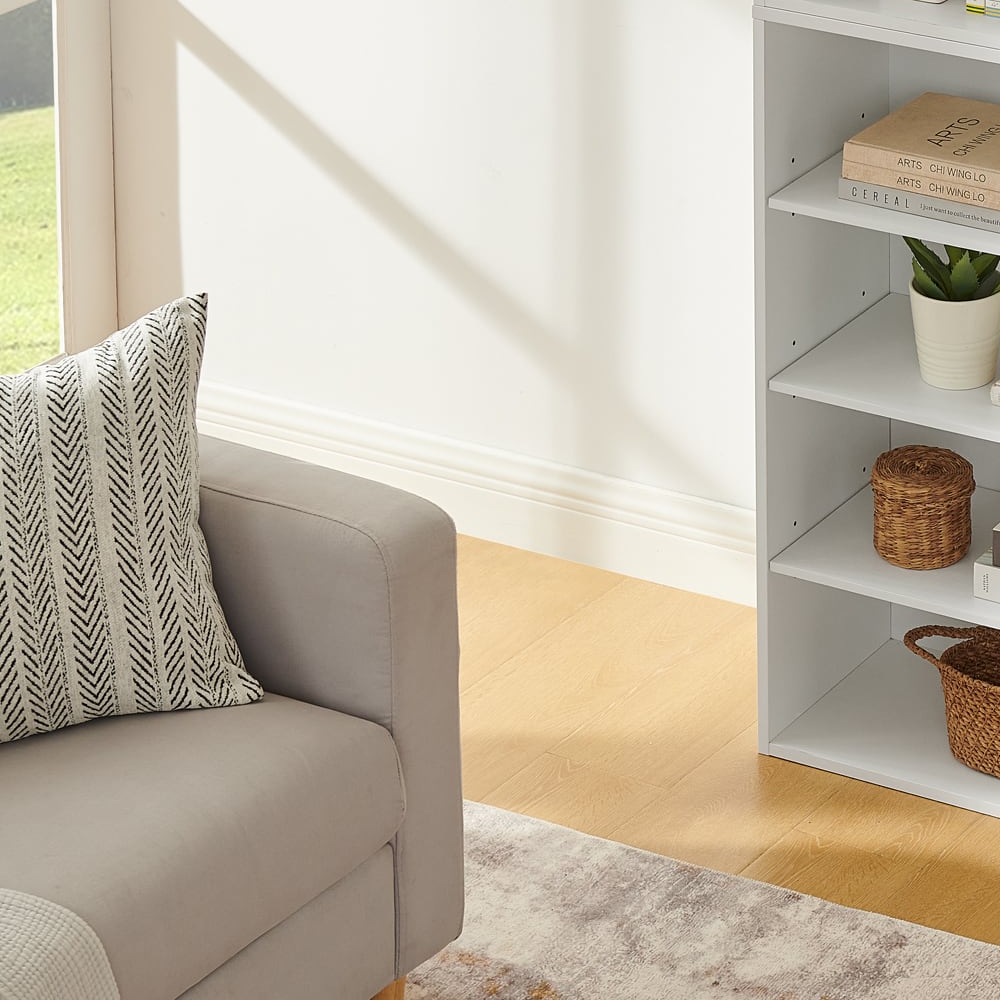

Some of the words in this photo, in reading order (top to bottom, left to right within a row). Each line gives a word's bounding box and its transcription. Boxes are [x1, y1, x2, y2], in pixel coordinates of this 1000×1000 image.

[927, 117, 980, 147] ARTS
[953, 144, 976, 156] CHI
[897, 158, 922, 170] ARTS
[930, 164, 945, 175] CHI
[947, 167, 972, 180] WING
[974, 173, 986, 182] LO
[897, 176, 921, 189] ARTS
[929, 183, 944, 193] CHI
[946, 186, 970, 199] WING
[972, 193, 985, 202] LO
[852, 187, 909, 208] CEREAL
[954, 211, 970, 219] collect
